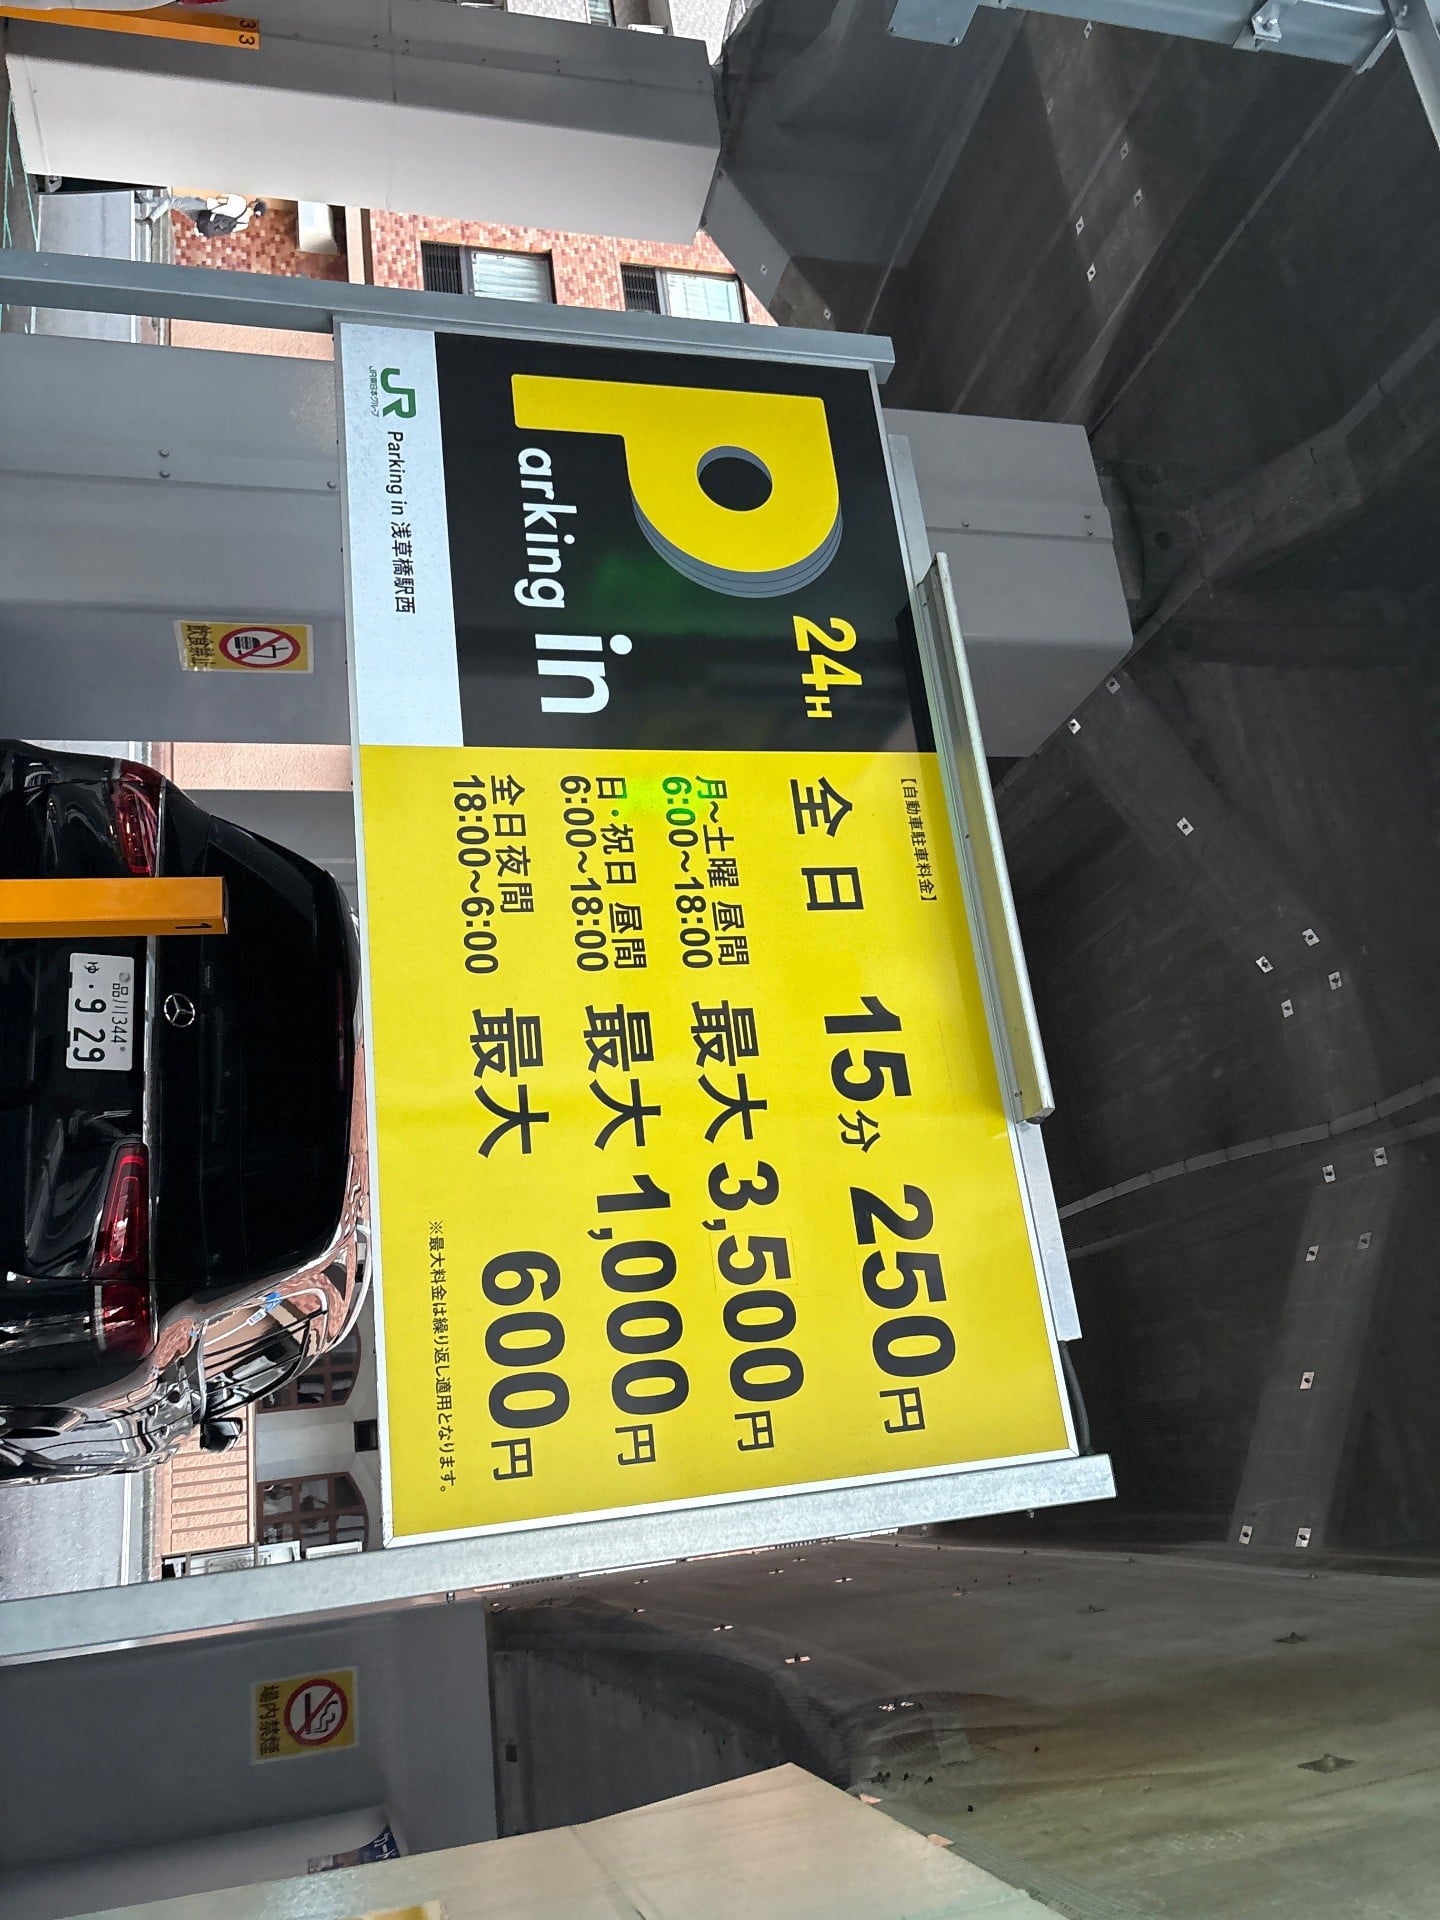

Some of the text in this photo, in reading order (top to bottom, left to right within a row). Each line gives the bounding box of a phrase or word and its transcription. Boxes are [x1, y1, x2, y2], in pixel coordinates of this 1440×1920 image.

[239, 34, 255, 45] 3
[240, 20, 256, 28] 3
[381, 368, 416, 418] JR
[386, 431, 415, 614] Parking in 浅草橋駅西
[186, 624, 218, 668] 飲食禁止
[535, 634, 632, 713] in
[793, 616, 862, 717] 24H
[490, 774, 534, 913] 全日夜間
[609, 903, 647, 968] 昼間
[711, 901, 749, 966] 昼間
[470, 1008, 549, 1157] 最大
[584, 1004, 661, 1150] 最大
[691, 1000, 767, 1143] 最大
[258, 1685, 281, 1755] 場内禁煙
